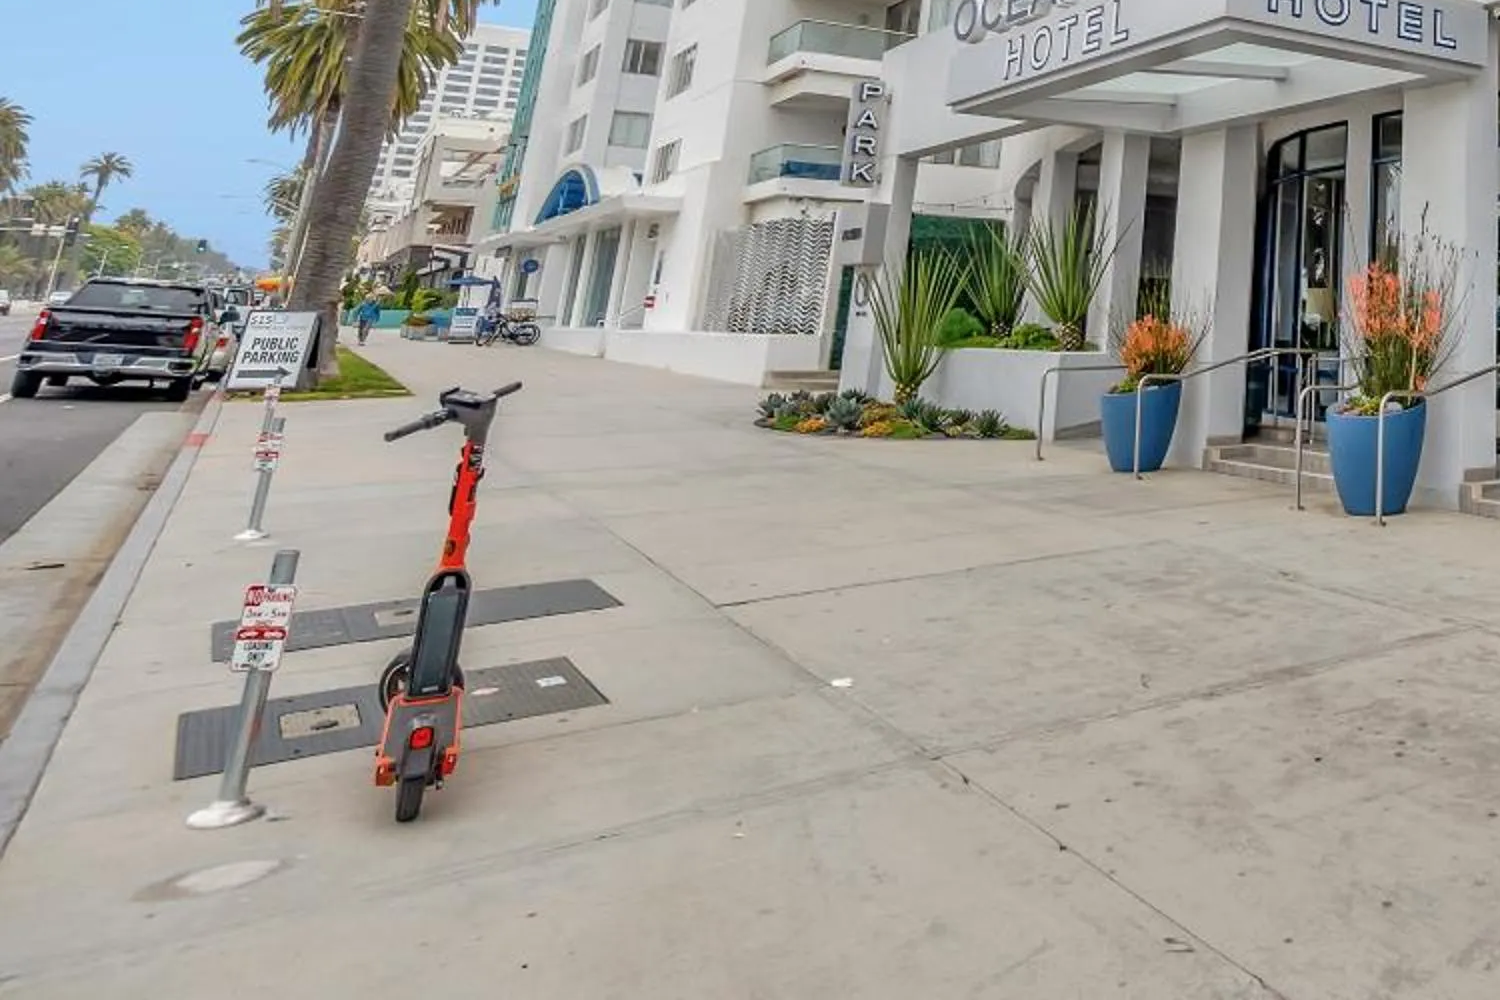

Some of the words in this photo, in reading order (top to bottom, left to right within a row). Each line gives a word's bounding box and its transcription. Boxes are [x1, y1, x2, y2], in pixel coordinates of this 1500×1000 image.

[850, 83, 883, 183] PARK
[251, 337, 299, 350] PUBLIC
[241, 351, 300, 364] PARKING
